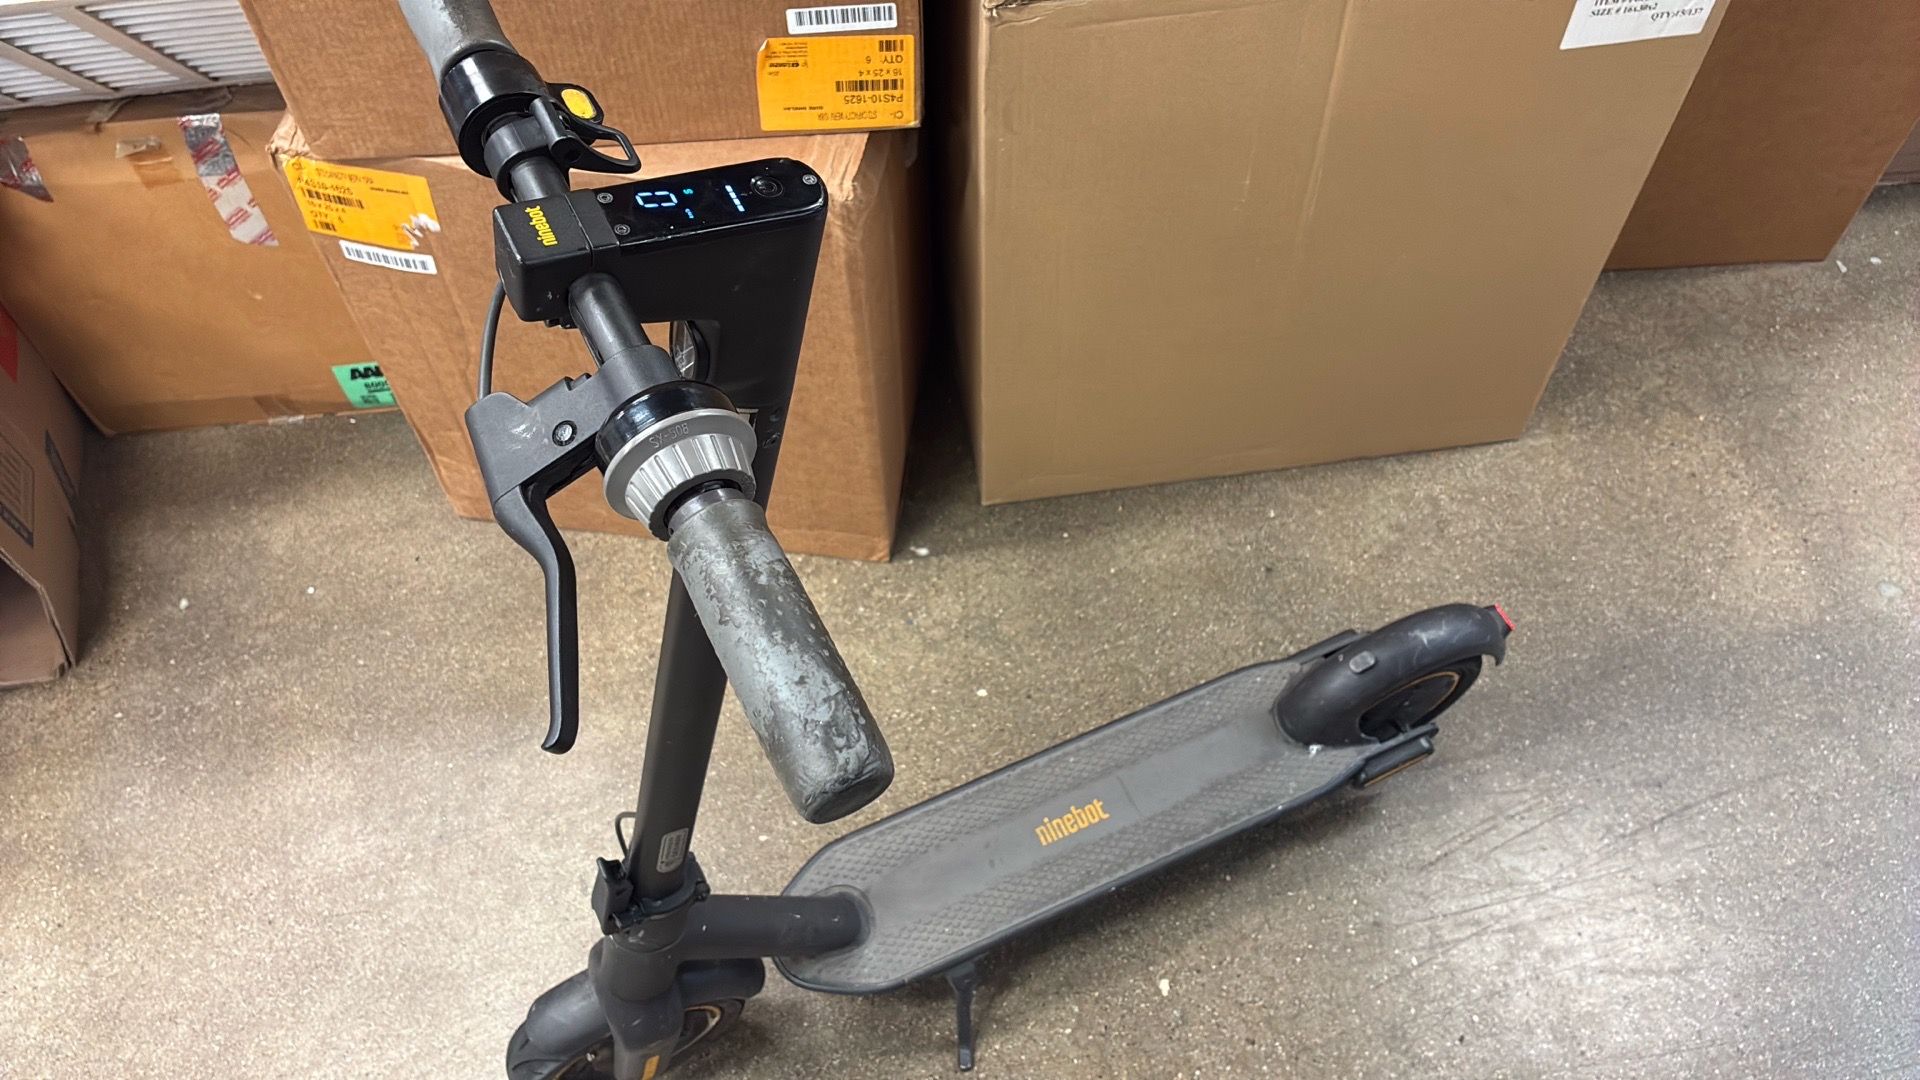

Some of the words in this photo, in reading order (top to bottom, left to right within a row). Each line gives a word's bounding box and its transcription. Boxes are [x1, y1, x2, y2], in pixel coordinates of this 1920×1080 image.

[1590, 8, 1614, 17] SIZE
[858, 69, 864, 77] 4
[873, 69, 883, 77] 25
[844, 94, 903, 104] P4S10-1625
[524, 205, 558, 246] ninebot
[1034, 799, 1110, 846] ninebot
